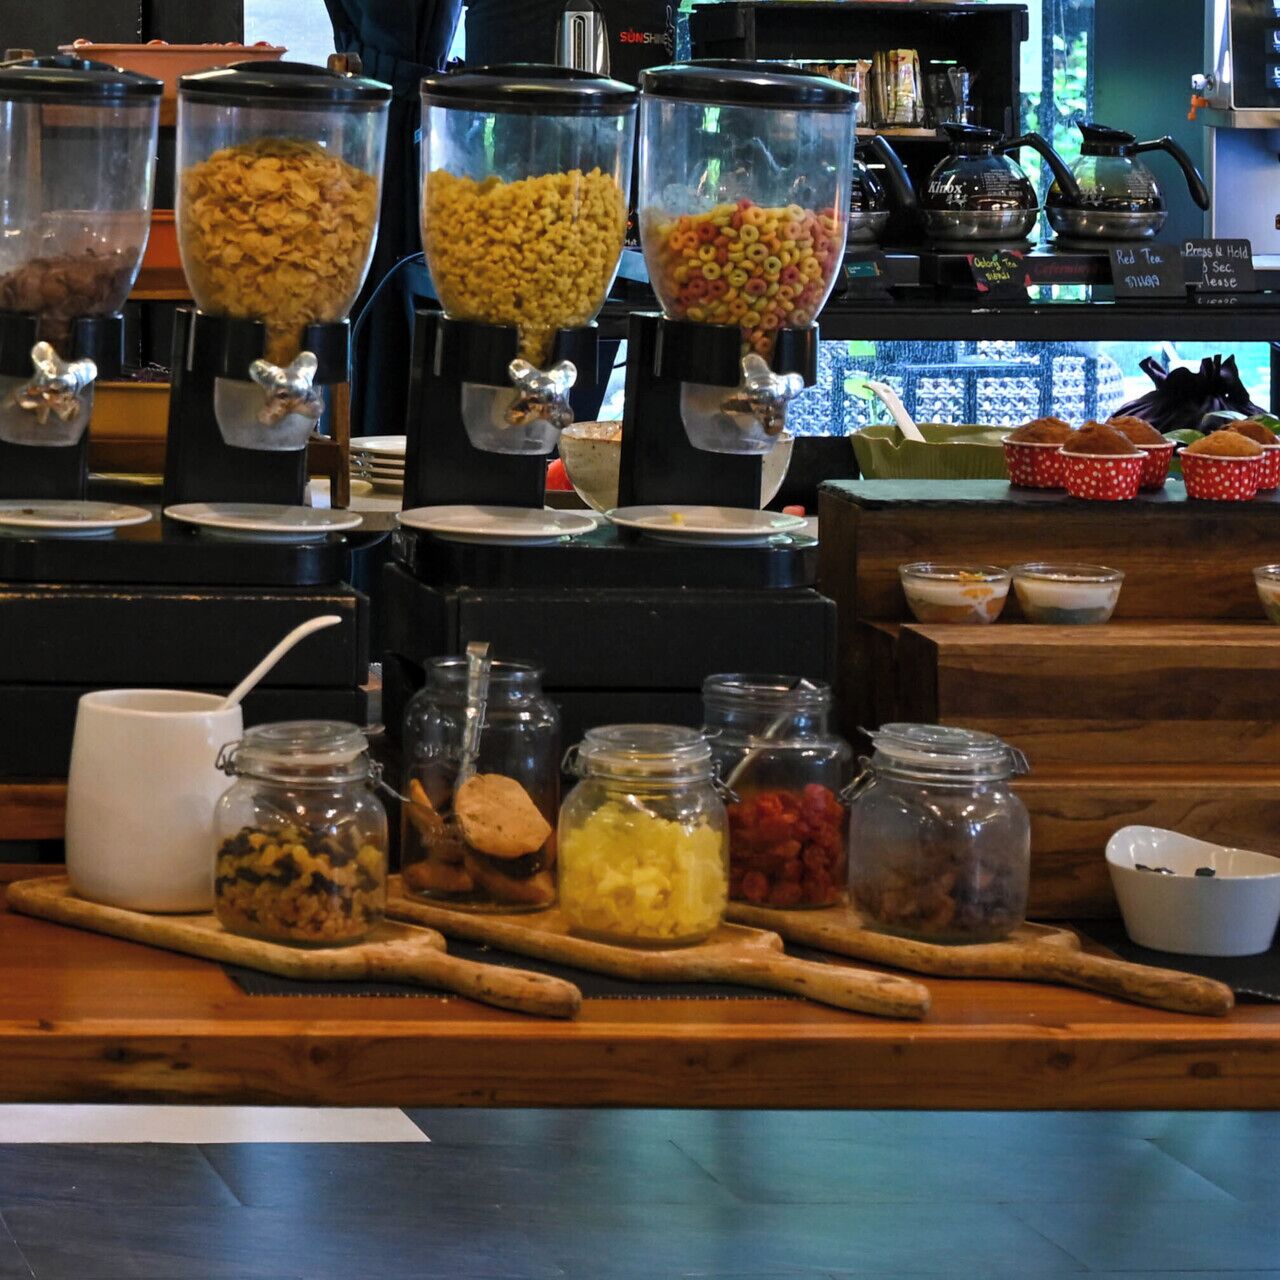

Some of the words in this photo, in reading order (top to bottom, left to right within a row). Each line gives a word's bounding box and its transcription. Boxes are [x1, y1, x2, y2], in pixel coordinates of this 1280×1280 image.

[1116, 248, 1135, 265] Red
[1141, 247, 1164, 265] Tea
[1227, 245, 1249, 259] Hold
[1198, 276, 1238, 289] lease
